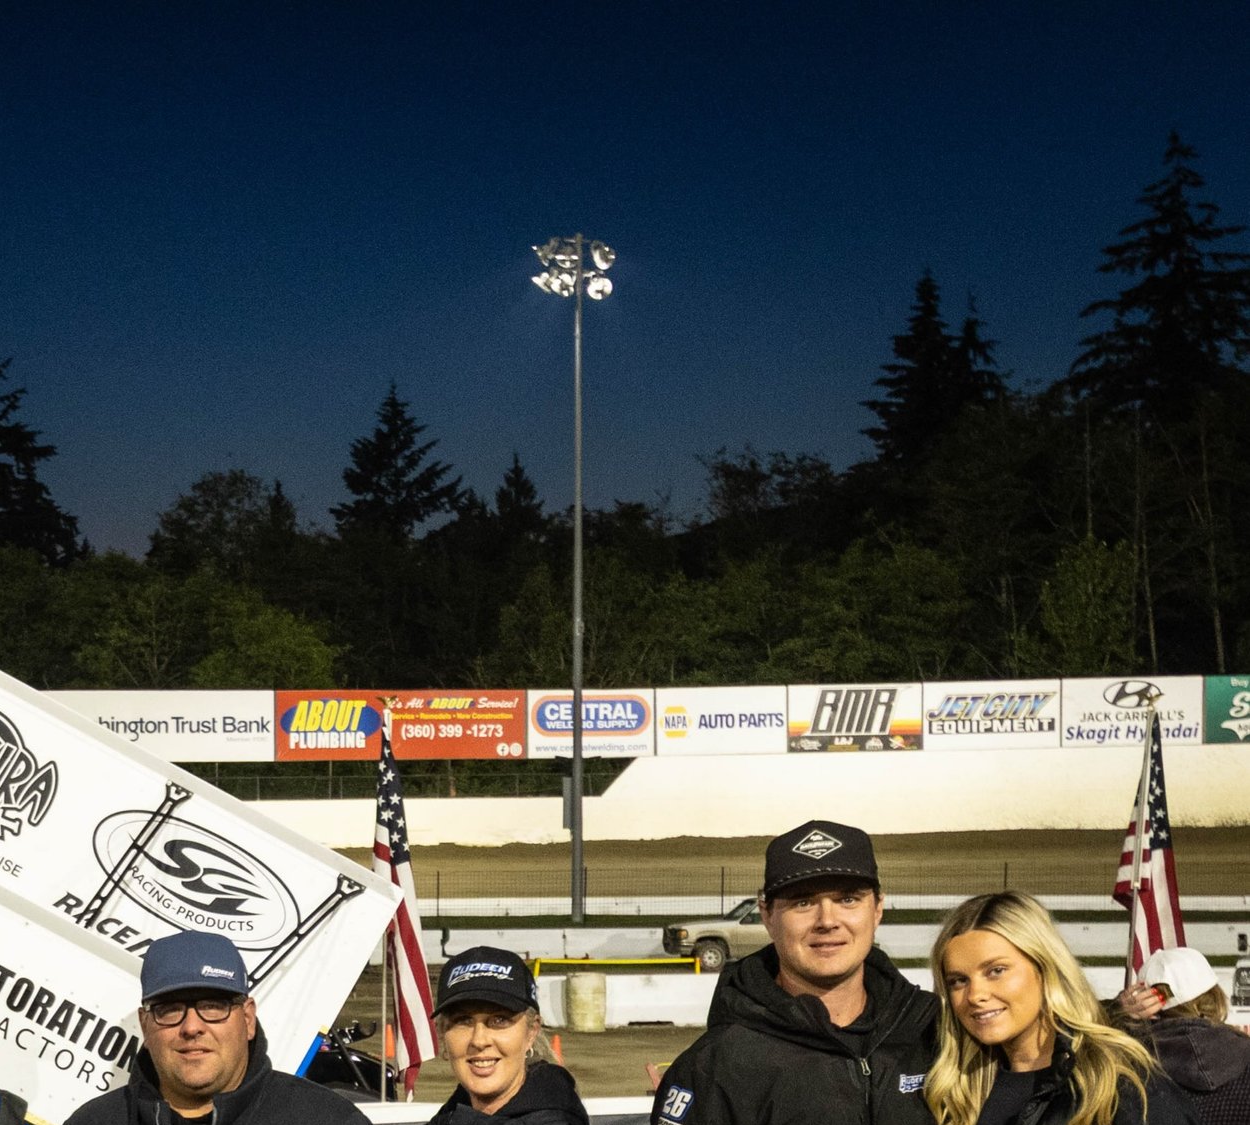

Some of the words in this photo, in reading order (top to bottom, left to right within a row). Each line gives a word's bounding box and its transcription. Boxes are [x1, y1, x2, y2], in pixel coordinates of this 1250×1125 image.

[429, 697, 473, 709] ABOUT
[926, 693, 984, 720] JET
[981, 692, 1056, 719] CITY
[171, 716, 217, 733] Trust
[223, 716, 270, 733] Bank
[291, 699, 367, 732] ABOUT
[596, 720, 638, 729] SUPPLY
[664, 715, 688, 729] NAPA
[699, 714, 735, 729] AUTO
[738, 712, 784, 728] PARTS
[1080, 710, 1111, 723] JACK
[1115, 709, 1185, 722] CARRLL'S
[401, 724, 435, 739] (360)
[438, 724, 463, 738] 399
[466, 724, 504, 738] -1273
[929, 717, 1056, 735] EQUIPMENT
[1064, 724, 1120, 744] Skagit
[1125, 721, 1200, 743] Hyndai
[289, 731, 366, 749] PLUMBING
[128, 864, 255, 932] RACING-PRODUCTS
[449, 962, 512, 983] RUDEEN
[661, 1087, 692, 1118] 26
